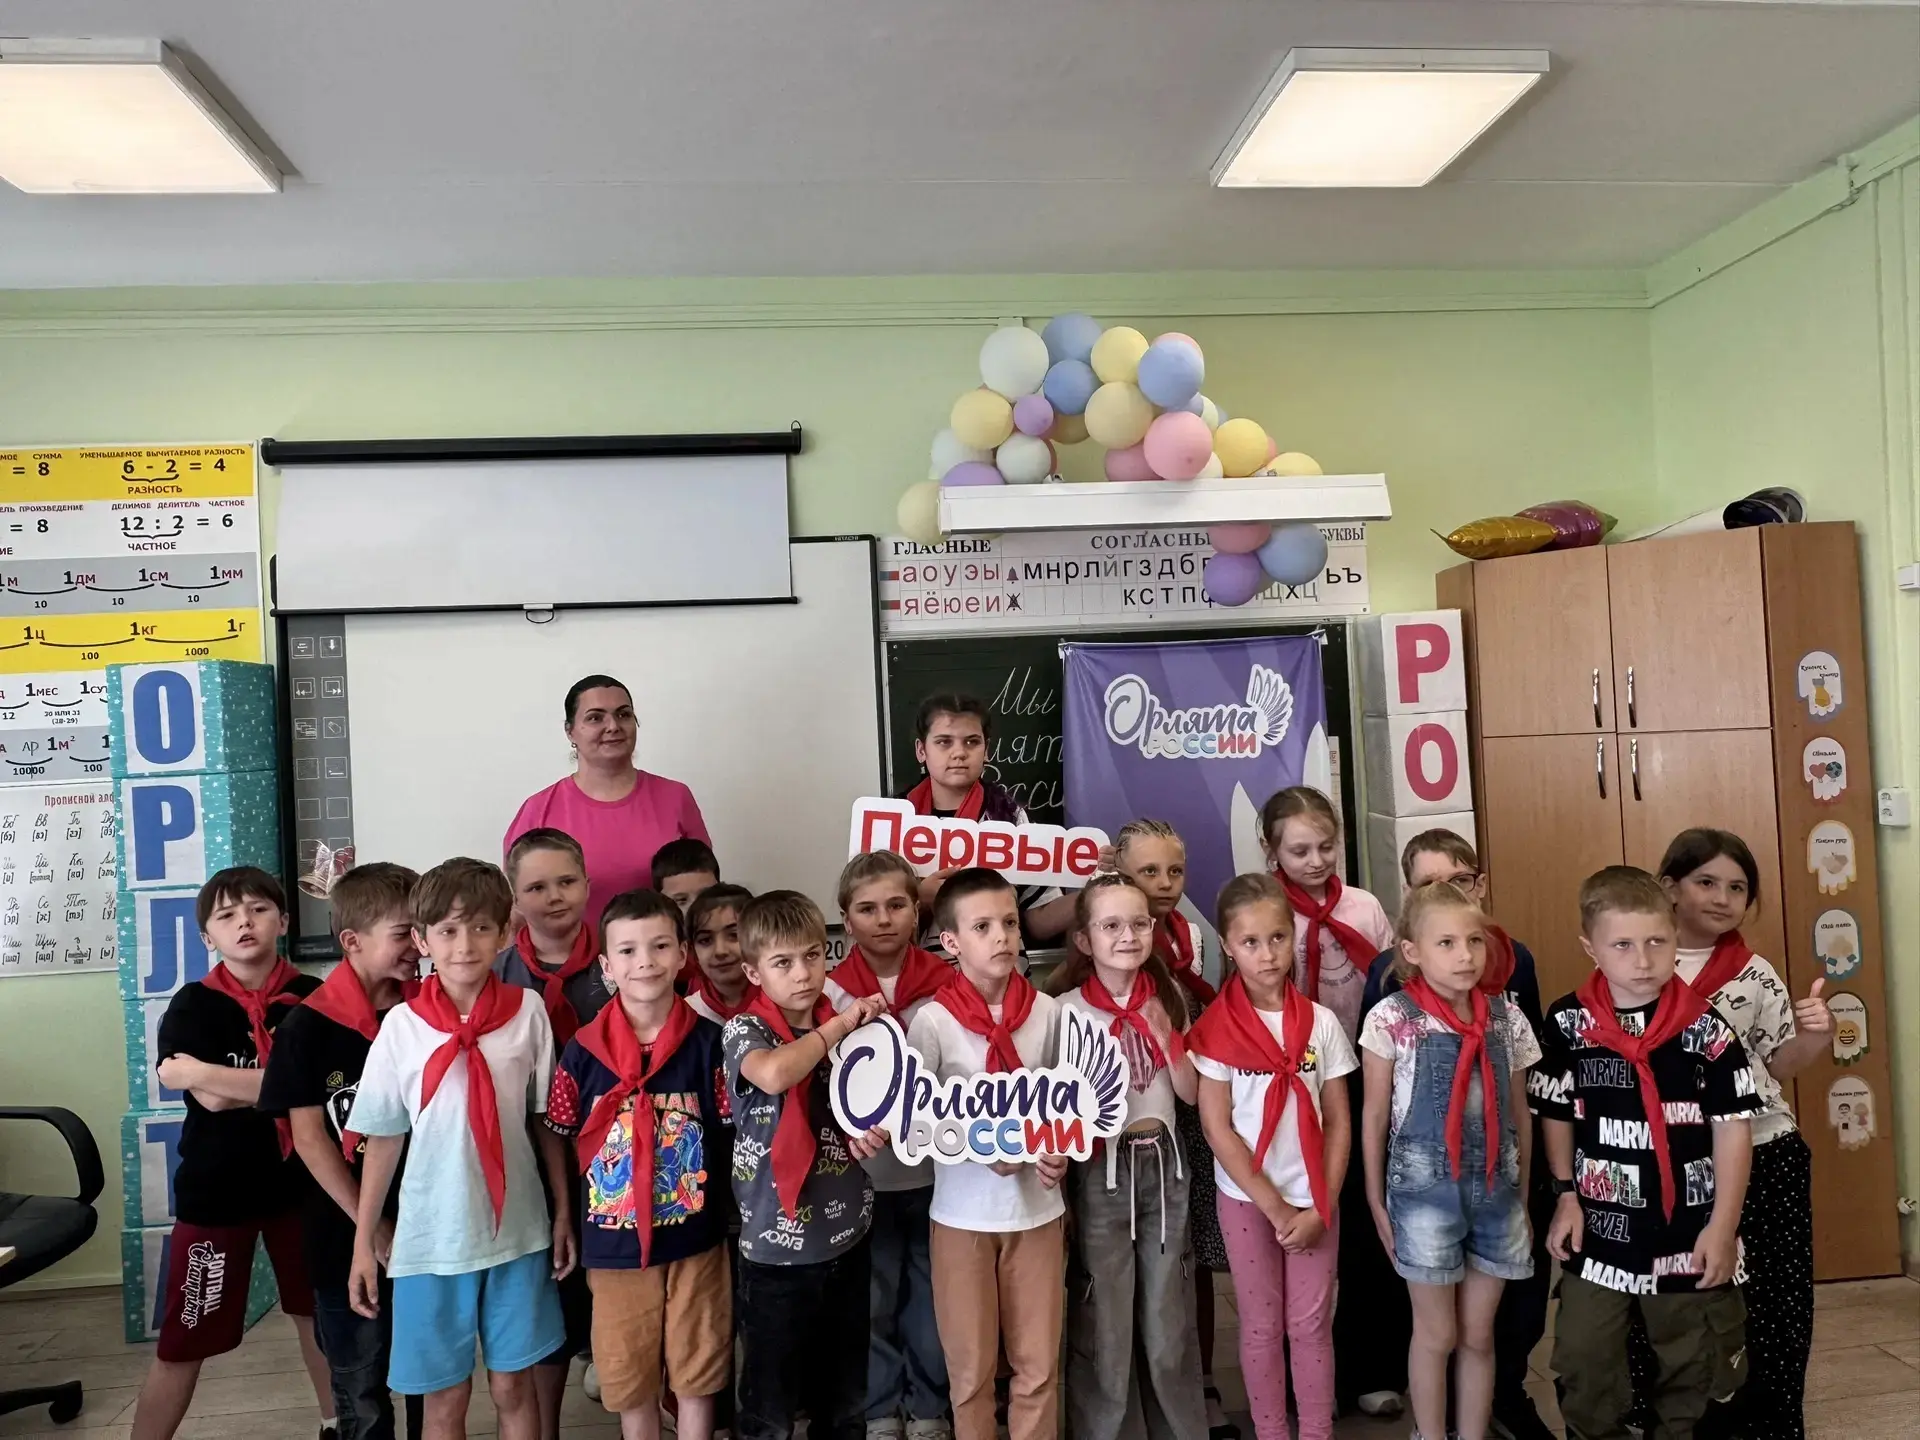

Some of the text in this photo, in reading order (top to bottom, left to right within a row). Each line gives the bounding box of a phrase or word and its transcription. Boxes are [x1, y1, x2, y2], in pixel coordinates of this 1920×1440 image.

[38, 462, 49, 476] 8
[123, 460, 135, 474] 6
[166, 459, 177, 473] 2
[214, 458, 226, 471] 4
[128, 485, 182, 494] РАЗНОСТЬ
[19, 504, 84, 512] ПРОИЗВЕДЕНИЕ
[111, 502, 151, 510] ДЕЛИМОЕ
[157, 501, 200, 509] ДЕЛИТЕЛЬ
[208, 499, 245, 507] ЧАСТНОЕ
[37, 519, 49, 533] 8
[120, 516, 144, 530] 12
[172, 515, 184, 529] 2
[222, 513, 233, 527] 6
[128, 542, 177, 550] ЧАСТНОЕ
[893, 539, 991, 555] ГЛАСНЫЕ
[1091, 532, 1211, 549] СОГЛАСНЫ
[34, 595, 200, 608] 10 10 10
[81, 647, 209, 660] 100 1000
[988, 666, 1056, 715] Мы
[2, 712, 16, 720] 12
[1109, 678, 1258, 747] Орлята
[83, 764, 103, 773] 100
[44, 793, 95, 807] Прописной
[861, 810, 1099, 876] Первые
[836, 1016, 1083, 1144] Орлята
[904, 1117, 1085, 1158] РОССИИ
[180, 1241, 215, 1330] Champions
[203, 1252, 226, 1316] FOOTBALL
